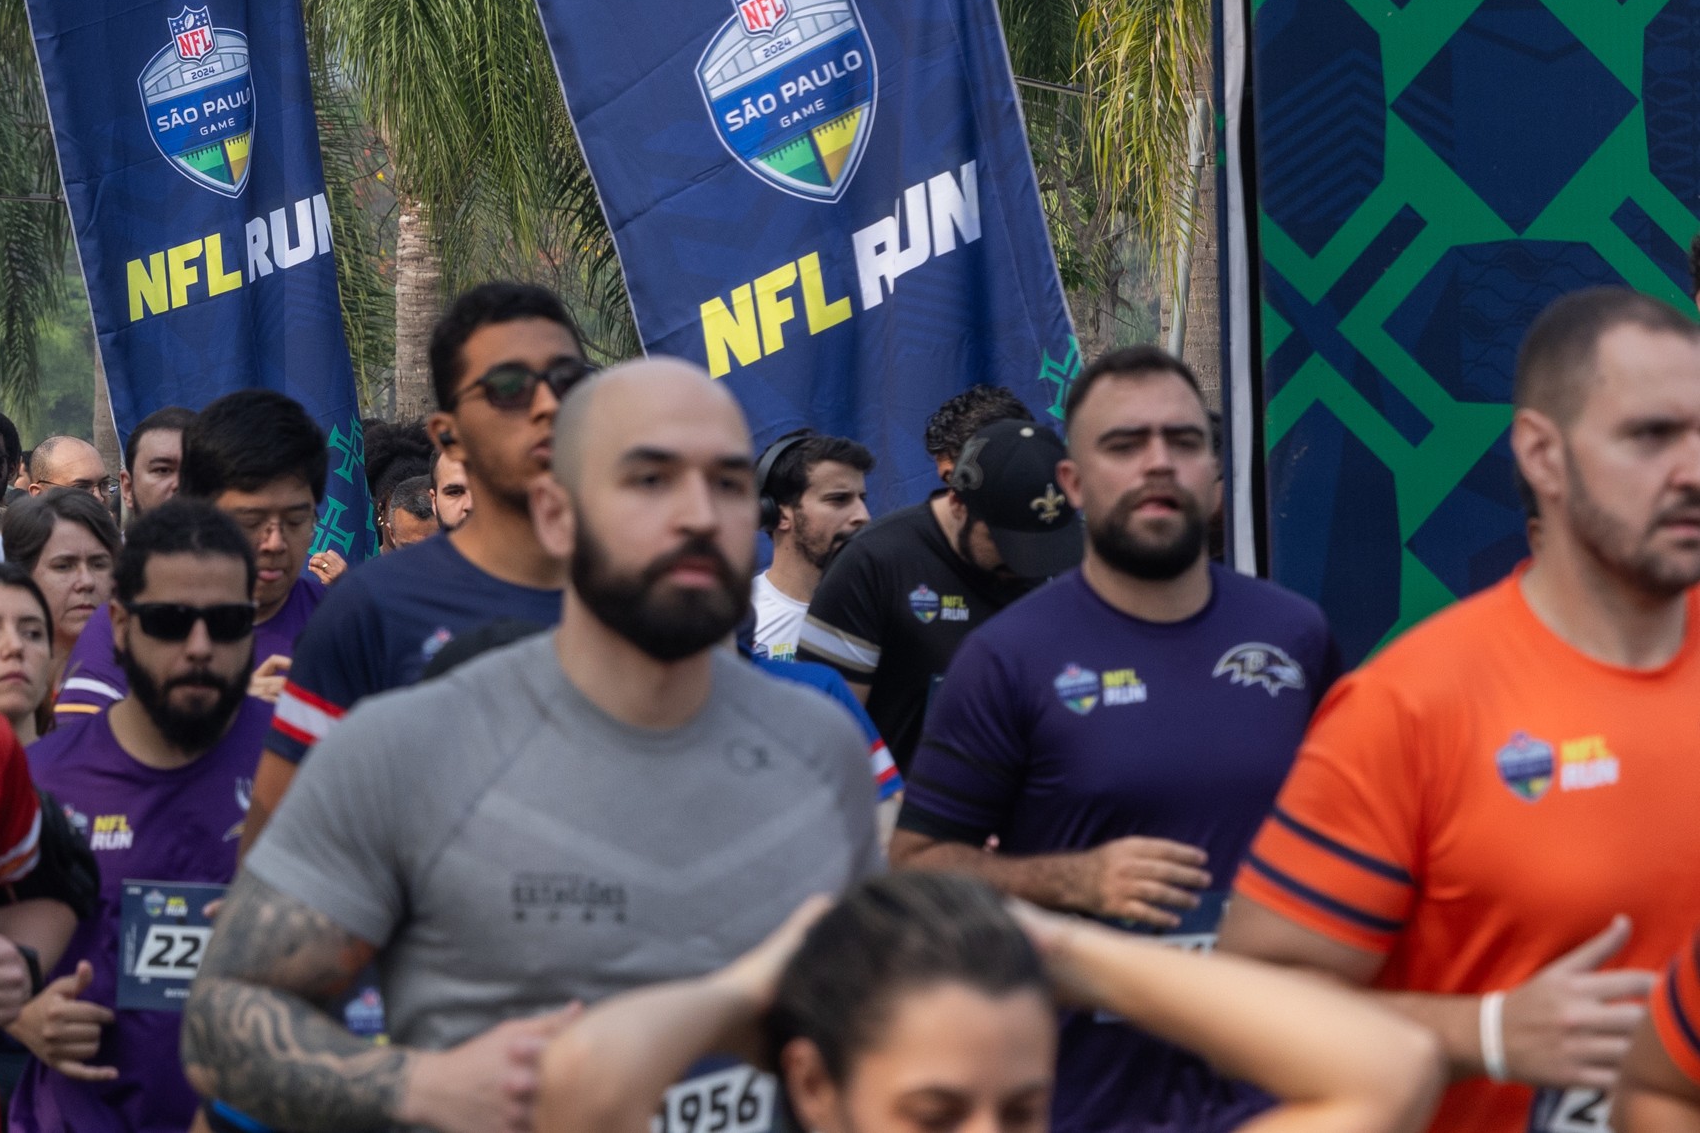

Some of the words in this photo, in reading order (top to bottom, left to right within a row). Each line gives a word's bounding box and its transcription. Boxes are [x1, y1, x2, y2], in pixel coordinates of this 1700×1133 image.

[177, 29, 213, 58] NFL
[762, 36, 792, 59] 2024
[190, 66, 215, 81] 2024
[725, 96, 778, 133] SÃO
[780, 49, 864, 103] PAULO
[157, 106, 198, 133] SÃO
[200, 118, 236, 136] GAME
[779, 98, 826, 129] GAME
[126, 232, 242, 323] NFL
[700, 251, 852, 380] NFL
[93, 815, 131, 833] NFL
[90, 830, 134, 851] RUN
